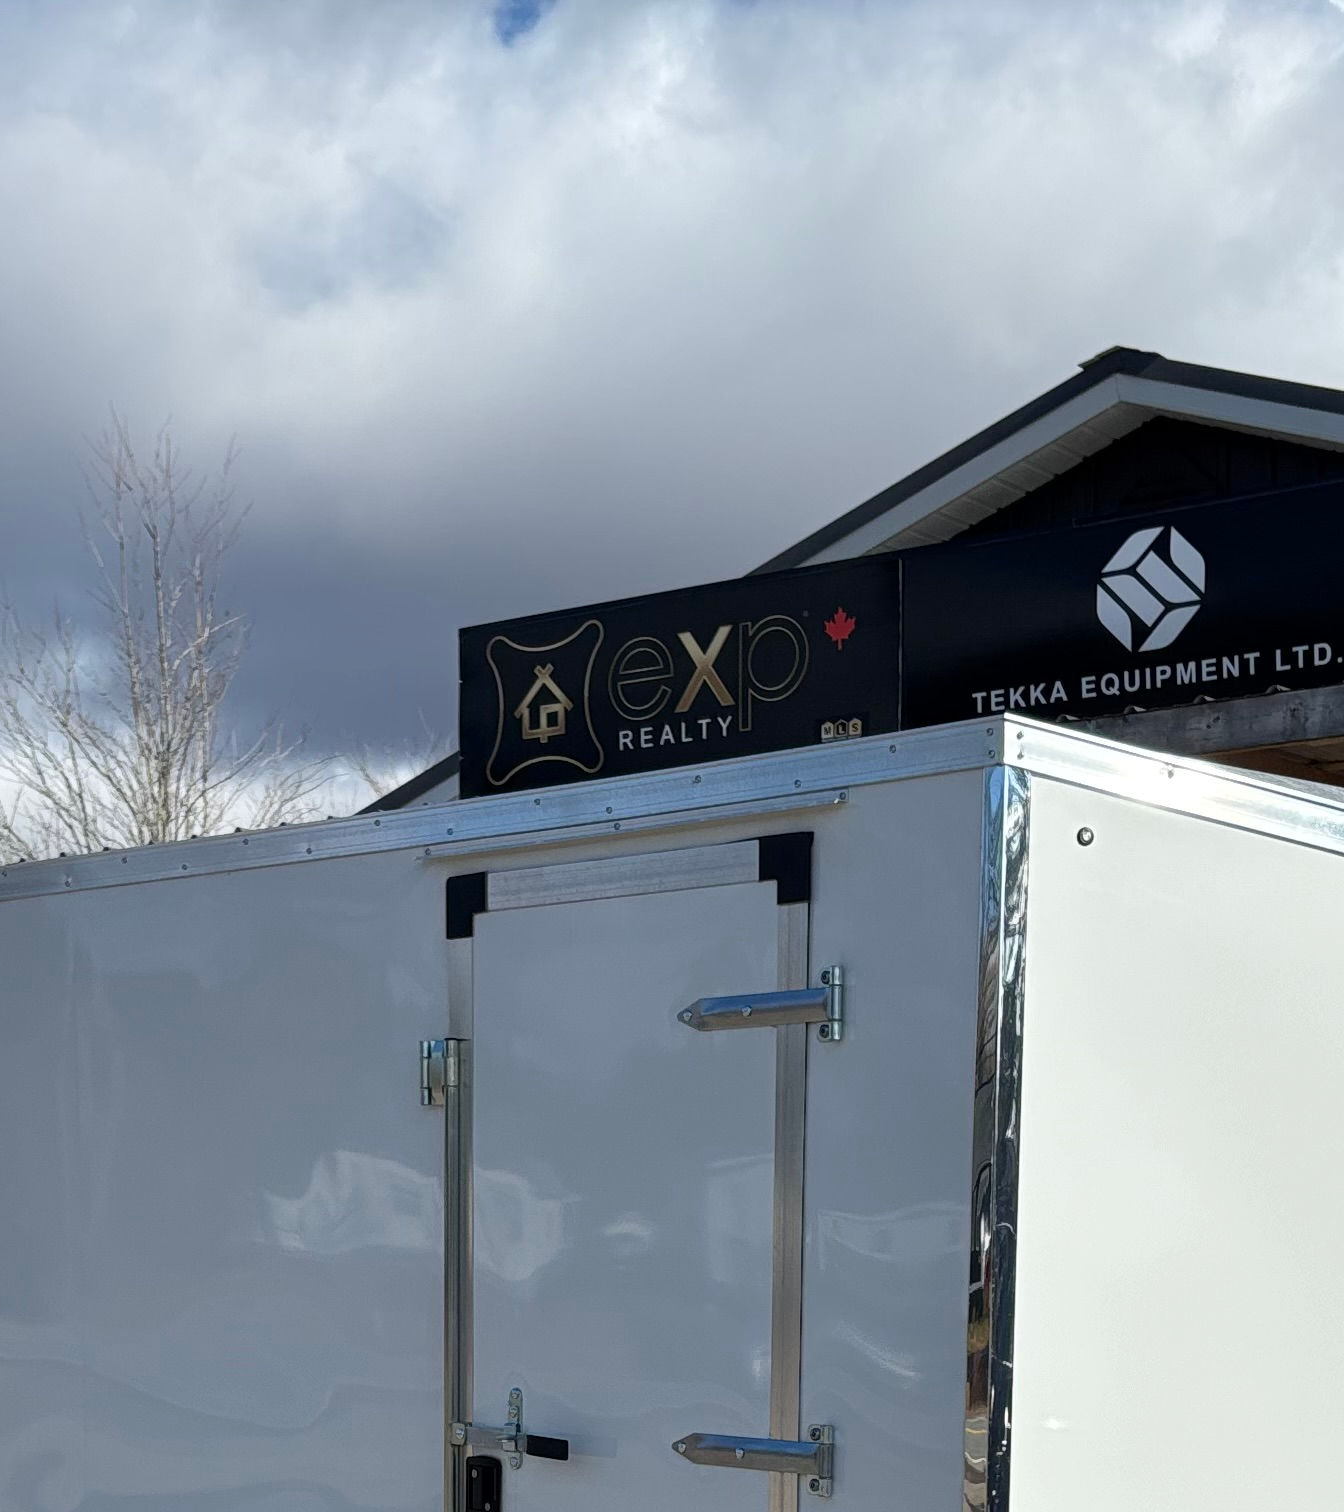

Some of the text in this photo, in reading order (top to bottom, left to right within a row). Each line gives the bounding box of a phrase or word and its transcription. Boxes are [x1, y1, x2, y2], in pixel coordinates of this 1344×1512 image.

[972, 642, 1344, 714] TEKKA EQUIPMENT LTD.
[619, 715, 733, 751] REALTY
[822, 720, 861, 738] MLS
